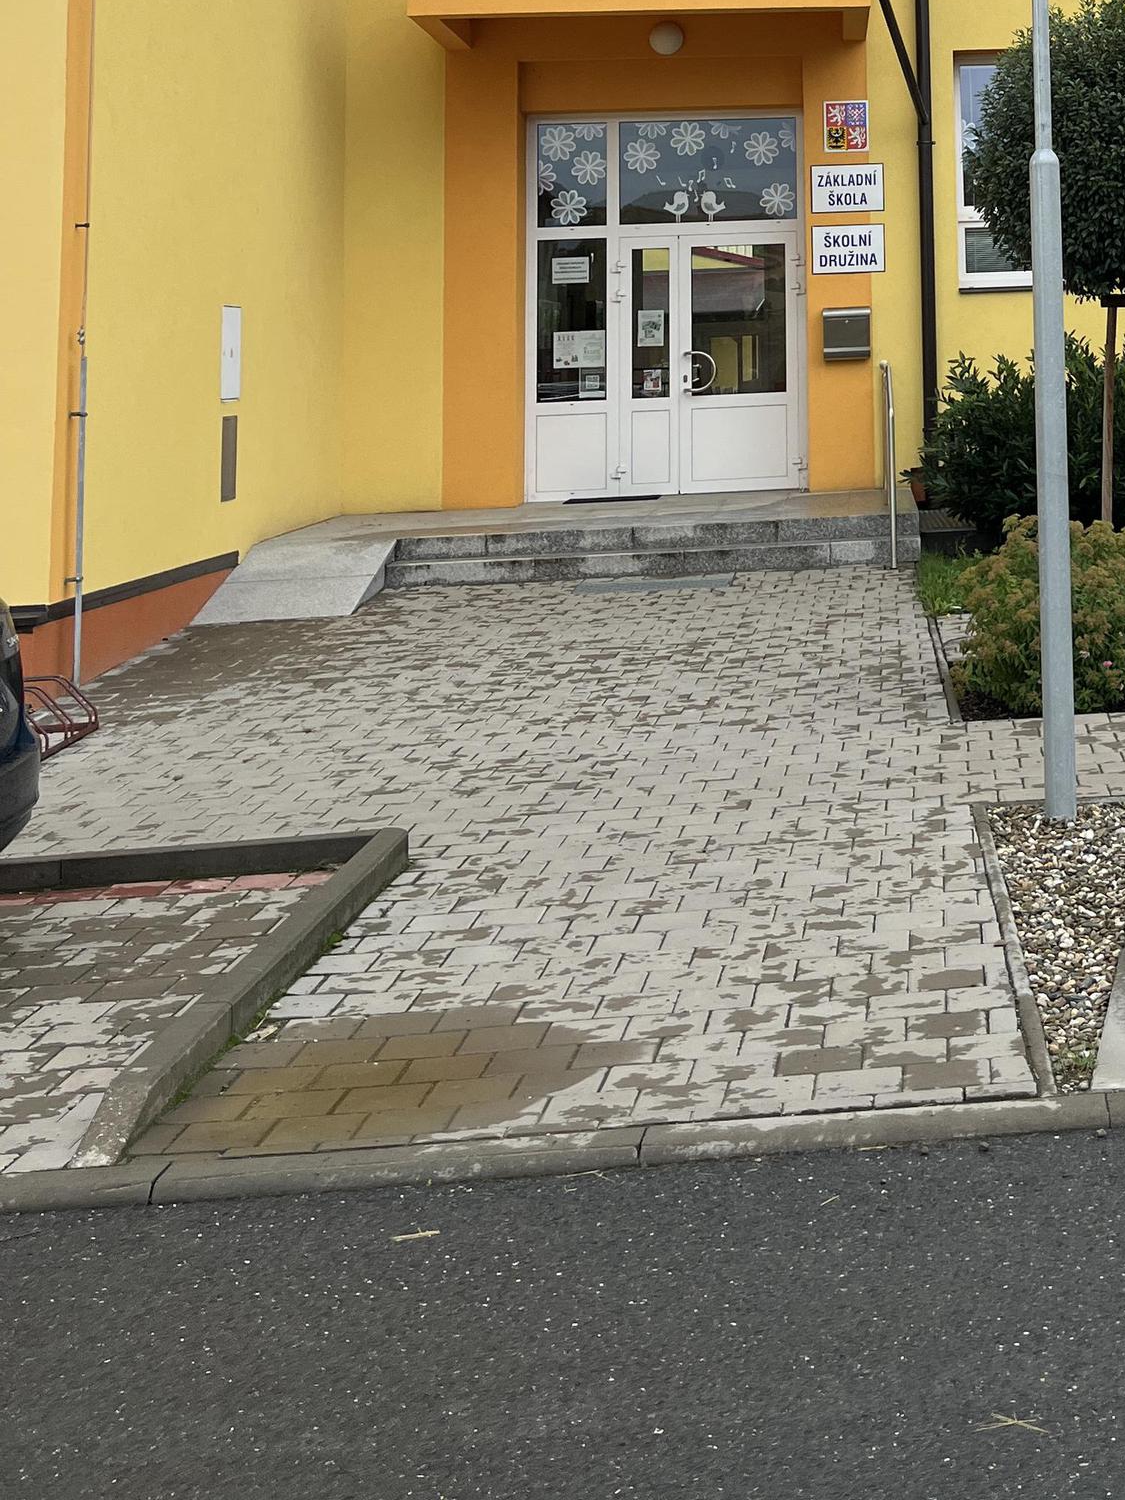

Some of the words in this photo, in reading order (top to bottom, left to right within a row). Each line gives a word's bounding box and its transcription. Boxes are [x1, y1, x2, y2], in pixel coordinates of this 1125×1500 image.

[817, 169, 877, 188] ZÁKLADNÍ
[828, 190, 868, 206] ŠKOLA
[823, 230, 872, 248] ŠKOLNÍ
[819, 250, 878, 267] DRUŽINA
